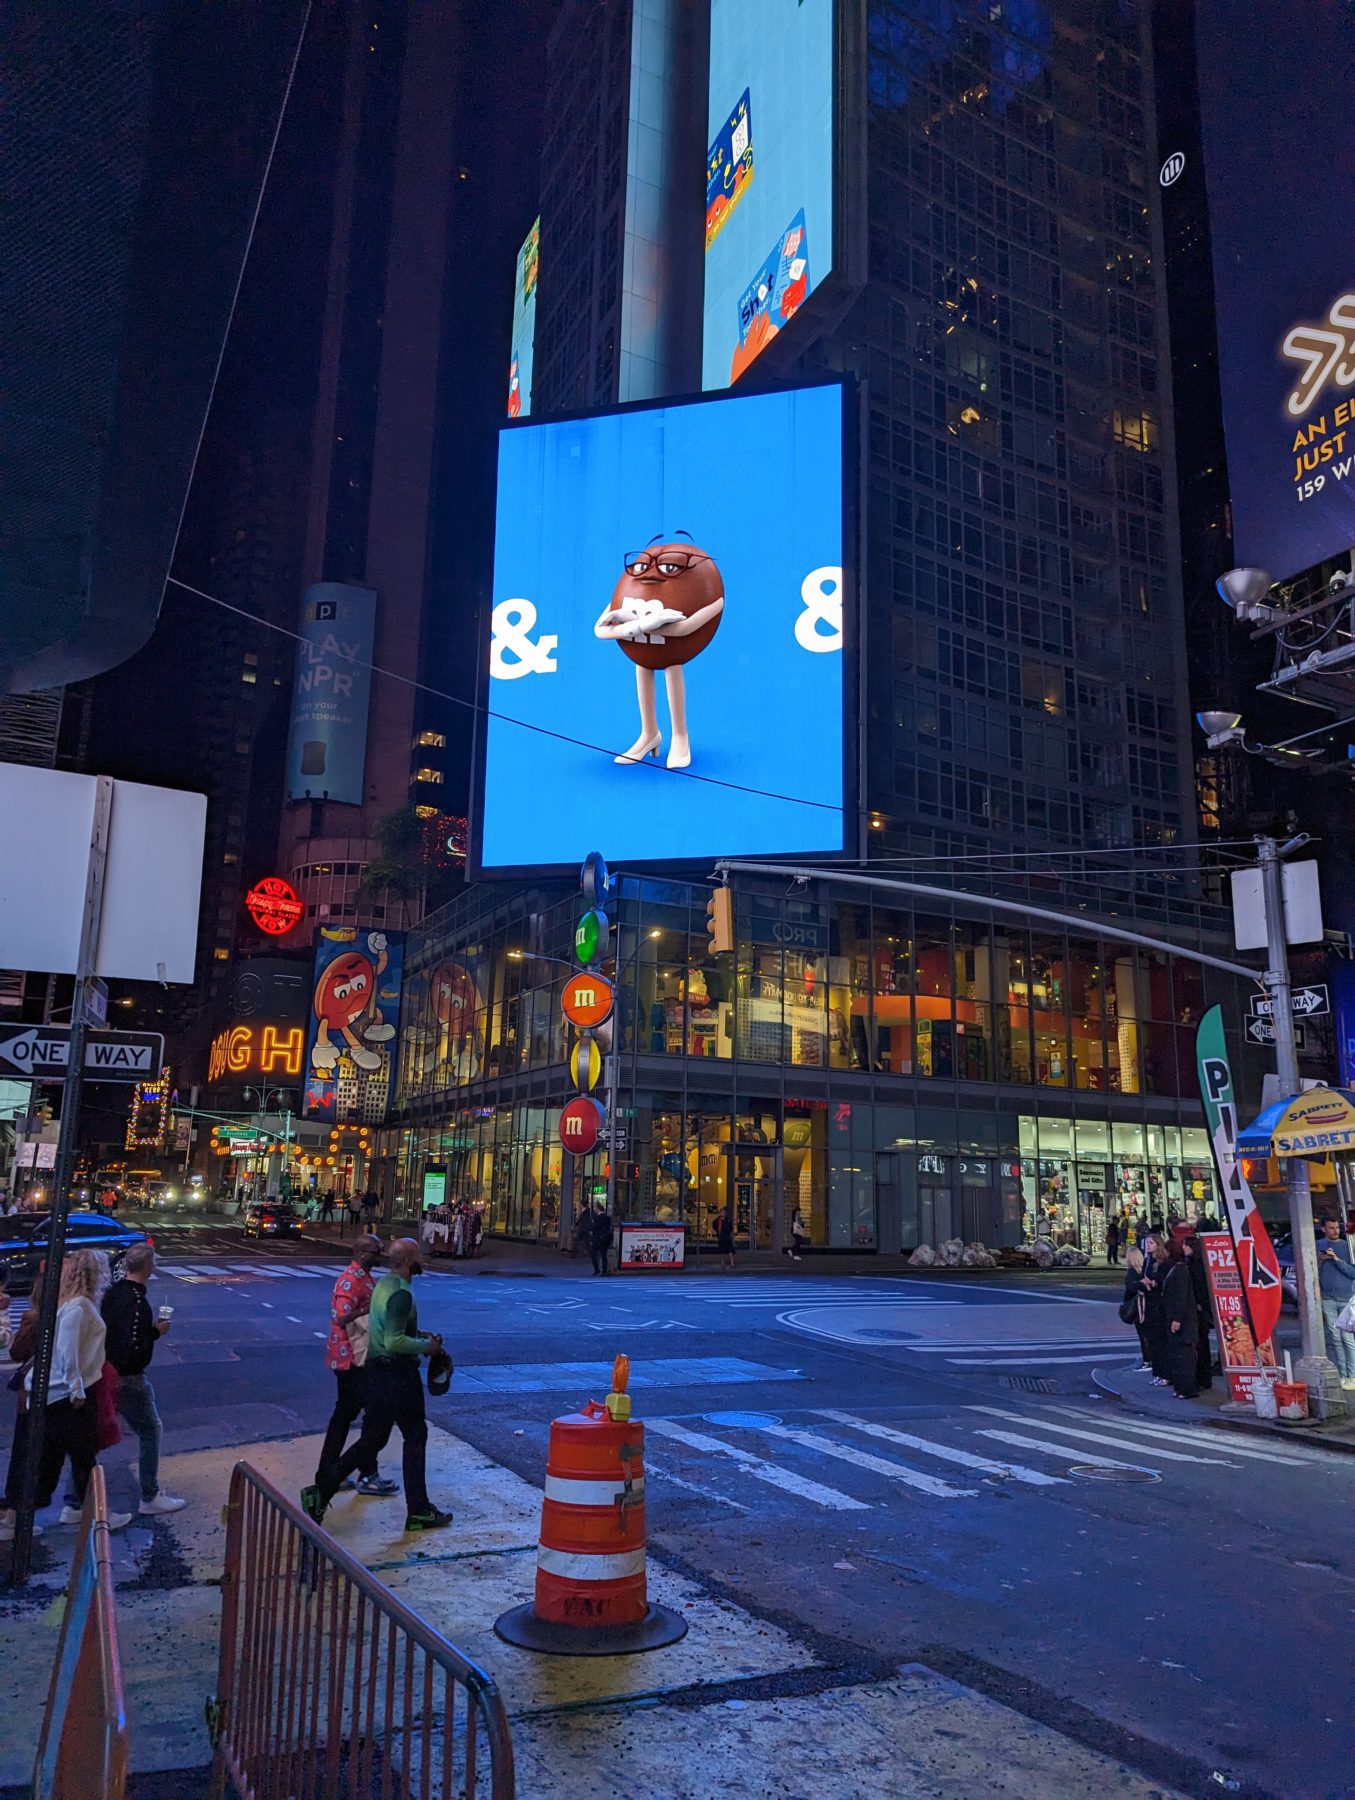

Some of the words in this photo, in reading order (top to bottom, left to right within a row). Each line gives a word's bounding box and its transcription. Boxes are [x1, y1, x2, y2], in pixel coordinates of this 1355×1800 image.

[1292, 415, 1327, 453] AN
[1294, 430, 1347, 482] JUST
[1296, 475, 1326, 502] 159
[1331, 455, 1355, 481] W
[490, 598, 558, 680] &
[264, 882, 289, 898] HOT
[574, 989, 595, 1007] m
[1292, 996, 1315, 1008] WAY
[1254, 1025, 1271, 1036] ONE
[12, 1041, 65, 1062] ONE
[95, 1046, 146, 1067] WAY
[1288, 1102, 1344, 1122] SABRETT
[565, 1116, 582, 1135] m
[1278, 1128, 1355, 1151] SABRET
